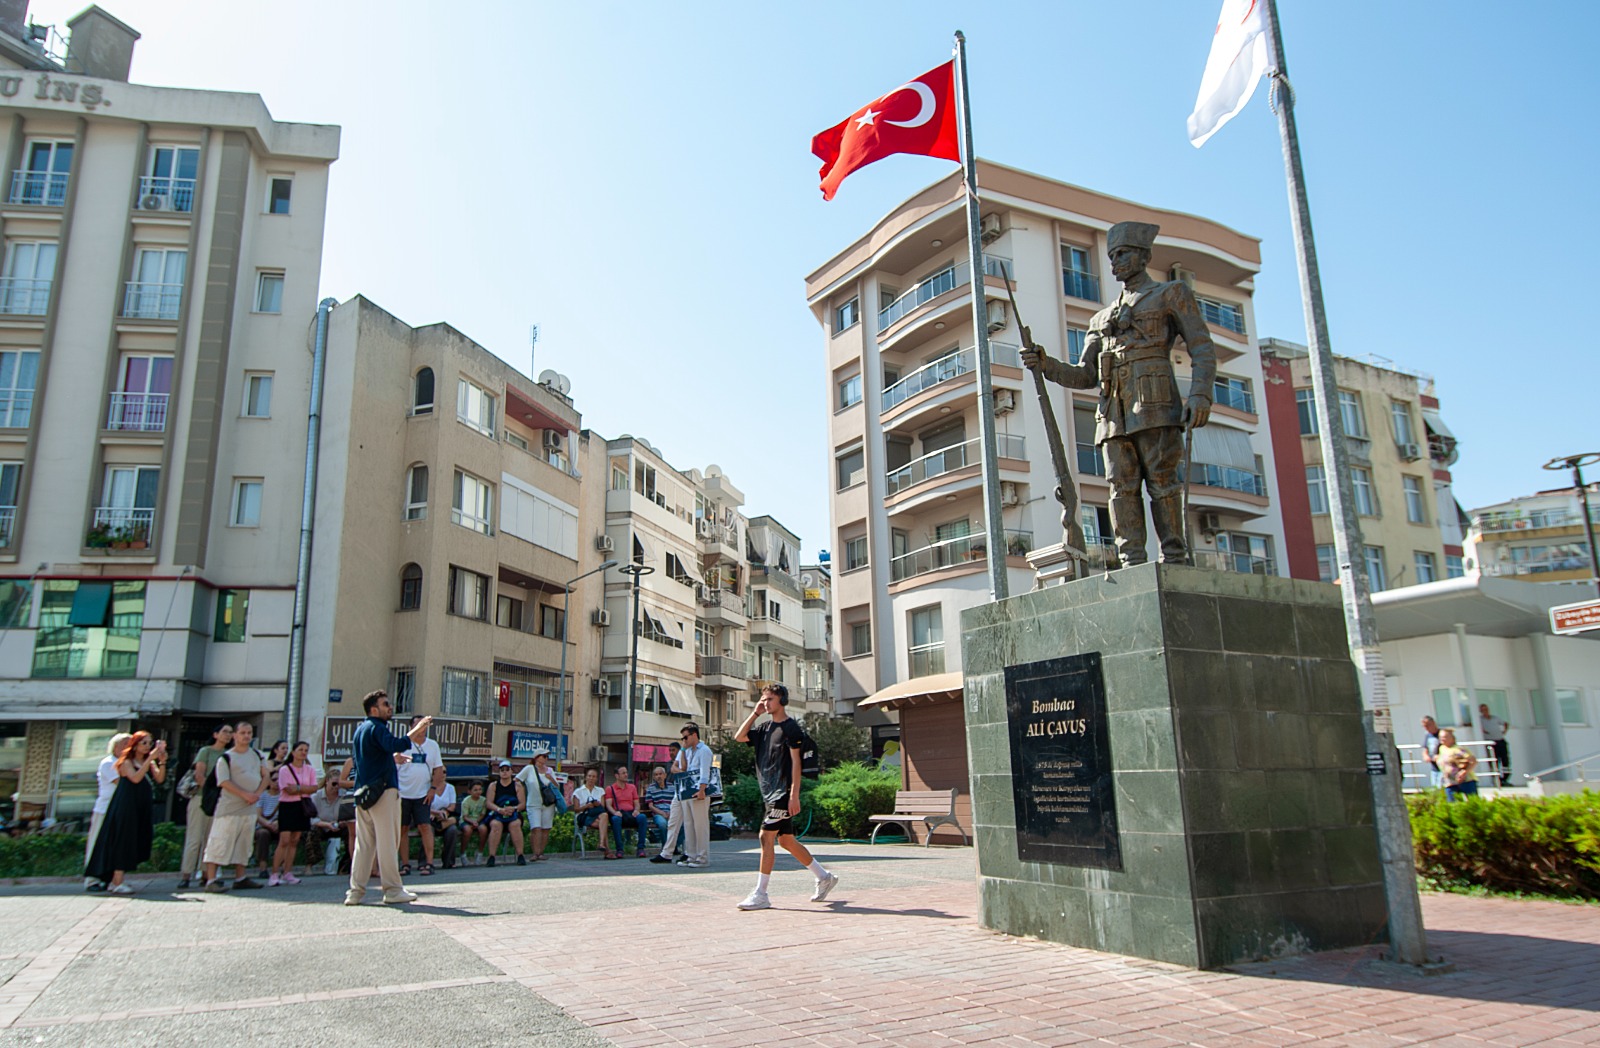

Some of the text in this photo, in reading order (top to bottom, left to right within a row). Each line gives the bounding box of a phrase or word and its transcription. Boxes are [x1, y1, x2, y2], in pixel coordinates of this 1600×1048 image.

[34, 73, 112, 111] İNŞ.
[1032, 697, 1075, 714] Bombacı
[435, 721, 488, 745] YILDIZ PİDE
[1026, 718, 1086, 739] ALİ ÇAVUŞ
[513, 739, 550, 751] AKDENİZ
